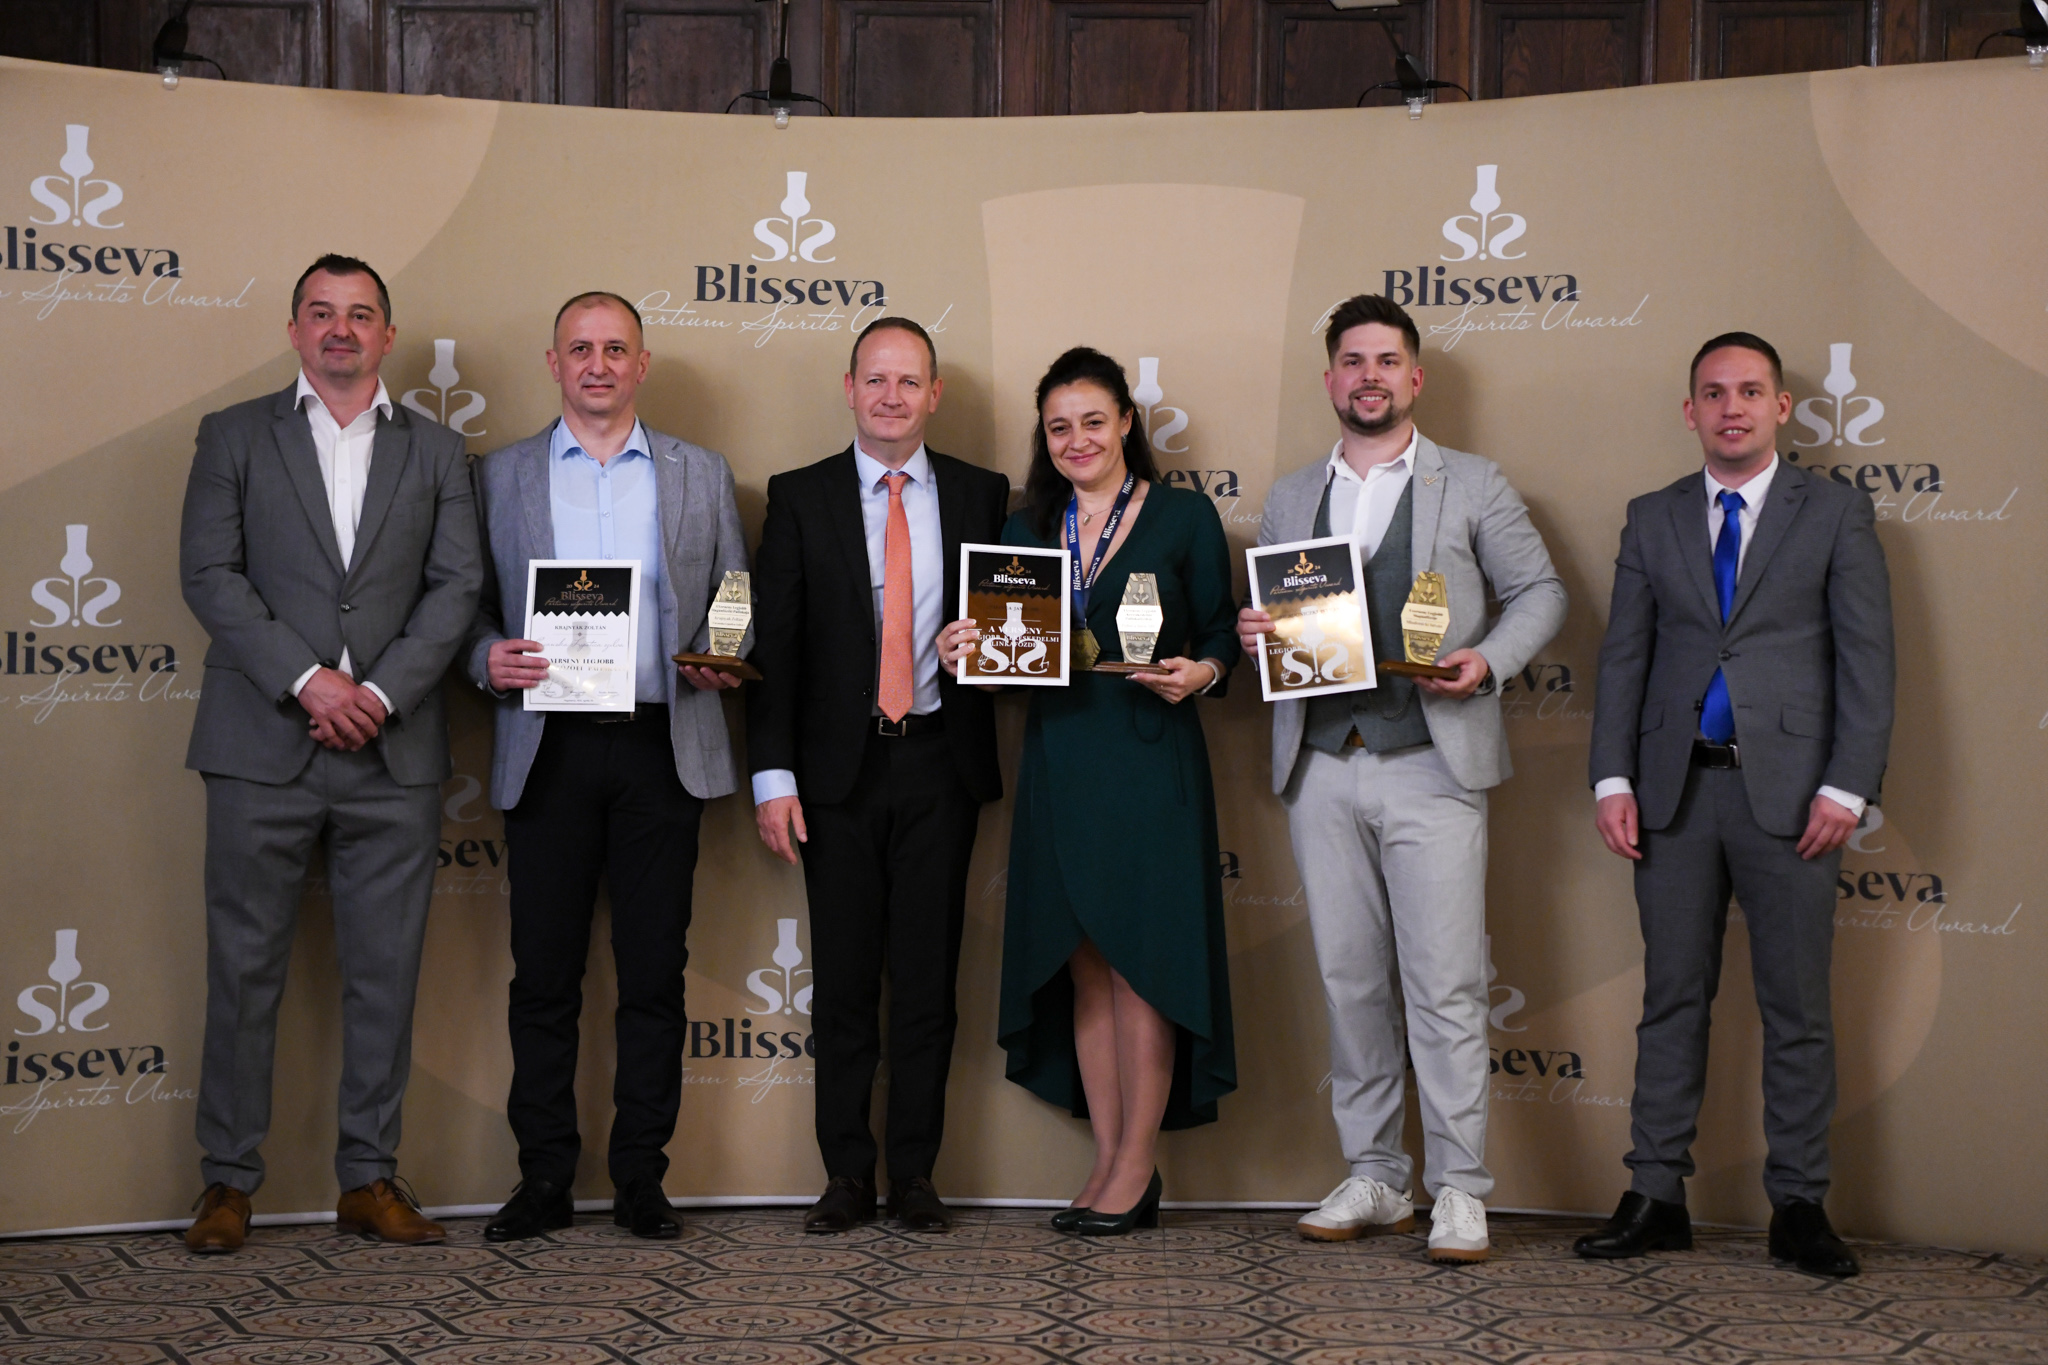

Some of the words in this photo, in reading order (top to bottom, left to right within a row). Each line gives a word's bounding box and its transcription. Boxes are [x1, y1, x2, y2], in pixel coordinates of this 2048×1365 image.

[0, 226, 182, 278] lisseva
[18, 263, 136, 321] Spirits
[143, 266, 256, 308] Award
[693, 263, 887, 307] Blisseva
[1382, 265, 1581, 307] Blisseva
[737, 295, 845, 349] Spirits
[1426, 295, 1536, 352] Spirits
[1541, 291, 1649, 331] Award
[1213, 487, 1263, 525] Awa
[1902, 481, 2019, 523] Award
[1068, 514, 1077, 544] Blisseva
[1102, 510, 1121, 539] Blisseva
[993, 574, 1036, 585] Blisseva
[1073, 560, 1082, 591] Blisseva
[1084, 556, 1101, 589] Blisseva
[1283, 574, 1327, 587] Blisseva
[560, 591, 604, 601] Blisseva
[0, 631, 179, 675] lisseva
[15, 664, 134, 724] Spirits
[139, 661, 201, 702] Awa
[1836, 869, 1947, 904] seva
[1907, 892, 2022, 935] Award
[687, 1018, 815, 1059] Bliss
[0, 1041, 168, 1086] isseva
[735, 1049, 815, 1104] Spiri
[0, 1070, 120, 1134] Spirits
[126, 1062, 200, 1105] Awa
[1550, 1068, 1631, 1107] Awar
